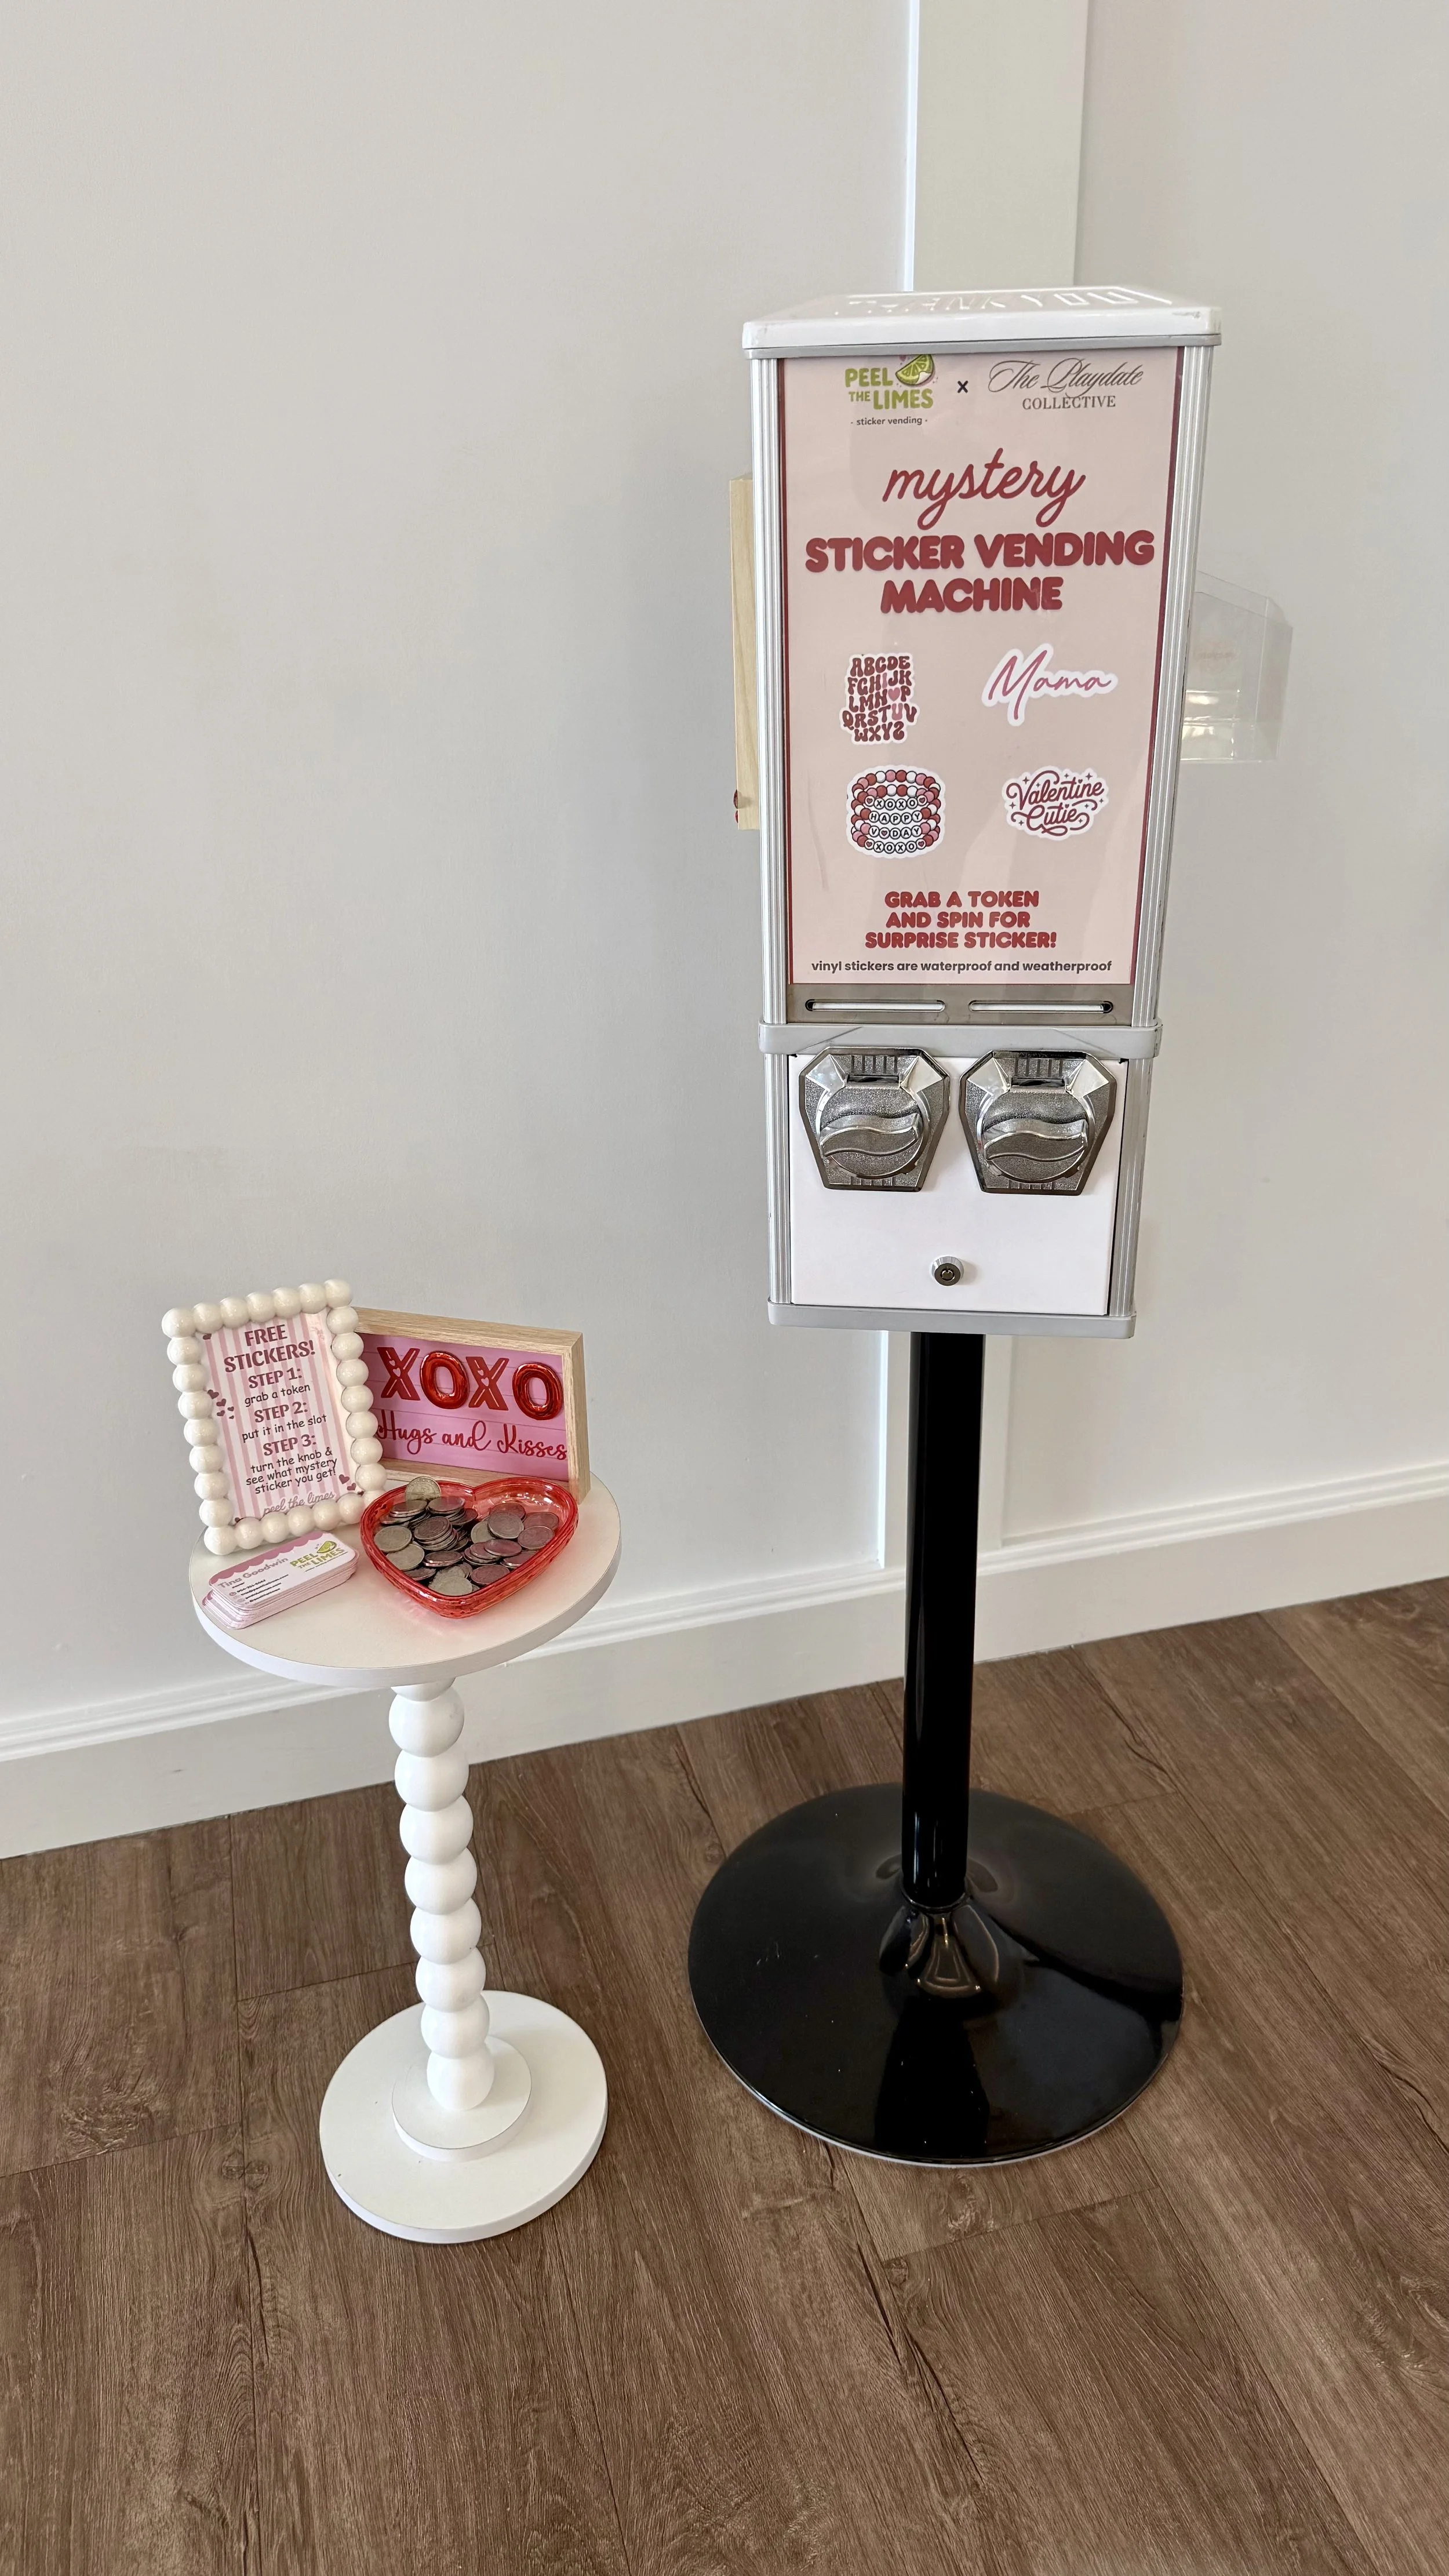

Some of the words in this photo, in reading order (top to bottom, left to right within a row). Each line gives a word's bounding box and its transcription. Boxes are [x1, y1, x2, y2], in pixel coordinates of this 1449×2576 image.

[844, 368, 893, 388] PEEL
[988, 360, 1040, 392] The
[1040, 358, 1144, 398] Playdate
[849, 391, 871, 402] THE
[873, 389, 933, 410] LIMES
[1022, 395, 1116, 410] COLLECTIVE
[888, 416, 922, 425] vending
[882, 447, 1086, 530] mystery
[805, 535, 964, 572] STICKER
[974, 530, 1155, 569] VENDING
[880, 577, 1064, 613] MACHINE
[850, 656, 911, 677] ABCDE
[988, 650, 1112, 720] Mama
[842, 703, 917, 730] QRSTUV
[1006, 770, 1104, 810] Valentine
[876, 800, 916, 808] XOXO
[871, 813, 920, 822] HAPPY
[1011, 802, 1090, 836] Cutie
[876, 843, 915, 851] XOXO
[884, 891, 941, 908] GRAB
[946, 891, 962, 908] A
[967, 890, 1039, 908] TOKEN
[886, 912, 931, 928] AND
[937, 911, 984, 928] SPIN
[989, 911, 1031, 928] FOR
[865, 932, 959, 948] SURPRISE
[964, 932, 1057, 948] STICKER!
[811, 960, 842, 974] vinyl
[844, 960, 894, 971] stickers
[897, 962, 918, 971] are
[920, 960, 992, 974] waterproof
[994, 961, 1020, 971] and
[1022, 960, 1112, 974] weatherproof
[244, 1324, 287, 1347] FREE
[224, 1340, 315, 1373] STICKERS!
[248, 1370, 283, 1388] STEP
[287, 1367, 303, 1380] 1:
[377, 1347, 563, 1421] XOXO
[245, 1392, 268, 1407] grab
[281, 1384, 311, 1396] token
[254, 1405, 289, 1422] STEP
[292, 1402, 308, 1414] 2:
[242, 1429, 259, 1443] put
[263, 1427, 271, 1435] it
[274, 1424, 284, 1433] in
[286, 1420, 305, 1430] the
[308, 1414, 326, 1425] slot
[376, 1409, 436, 1455] Hugs
[442, 1420, 492, 1451] and
[497, 1424, 567, 1460] Kisses
[263, 1437, 298, 1456] STEP
[301, 1434, 316, 1447] 3:
[250, 1462, 274, 1473] turn
[276, 1457, 294, 1468] the
[297, 1450, 322, 1462] knob
[325, 1447, 332, 1456] &
[246, 1476, 264, 1486] see
[267, 1468, 292, 1480] what
[296, 1458, 337, 1474] mystery
[255, 1480, 292, 1494] sticker
[295, 1474, 313, 1487] you
[316, 1468, 336, 1482] get!
[264, 1498, 286, 1515] peel
[288, 1496, 305, 1508] the
[307, 1491, 335, 1504] limes
[290, 1553, 318, 1567] PEEL
[311, 1548, 344, 1565] LIMES
[218, 1578, 242, 1588] Tina
[243, 1558, 289, 1578] Goodwin
